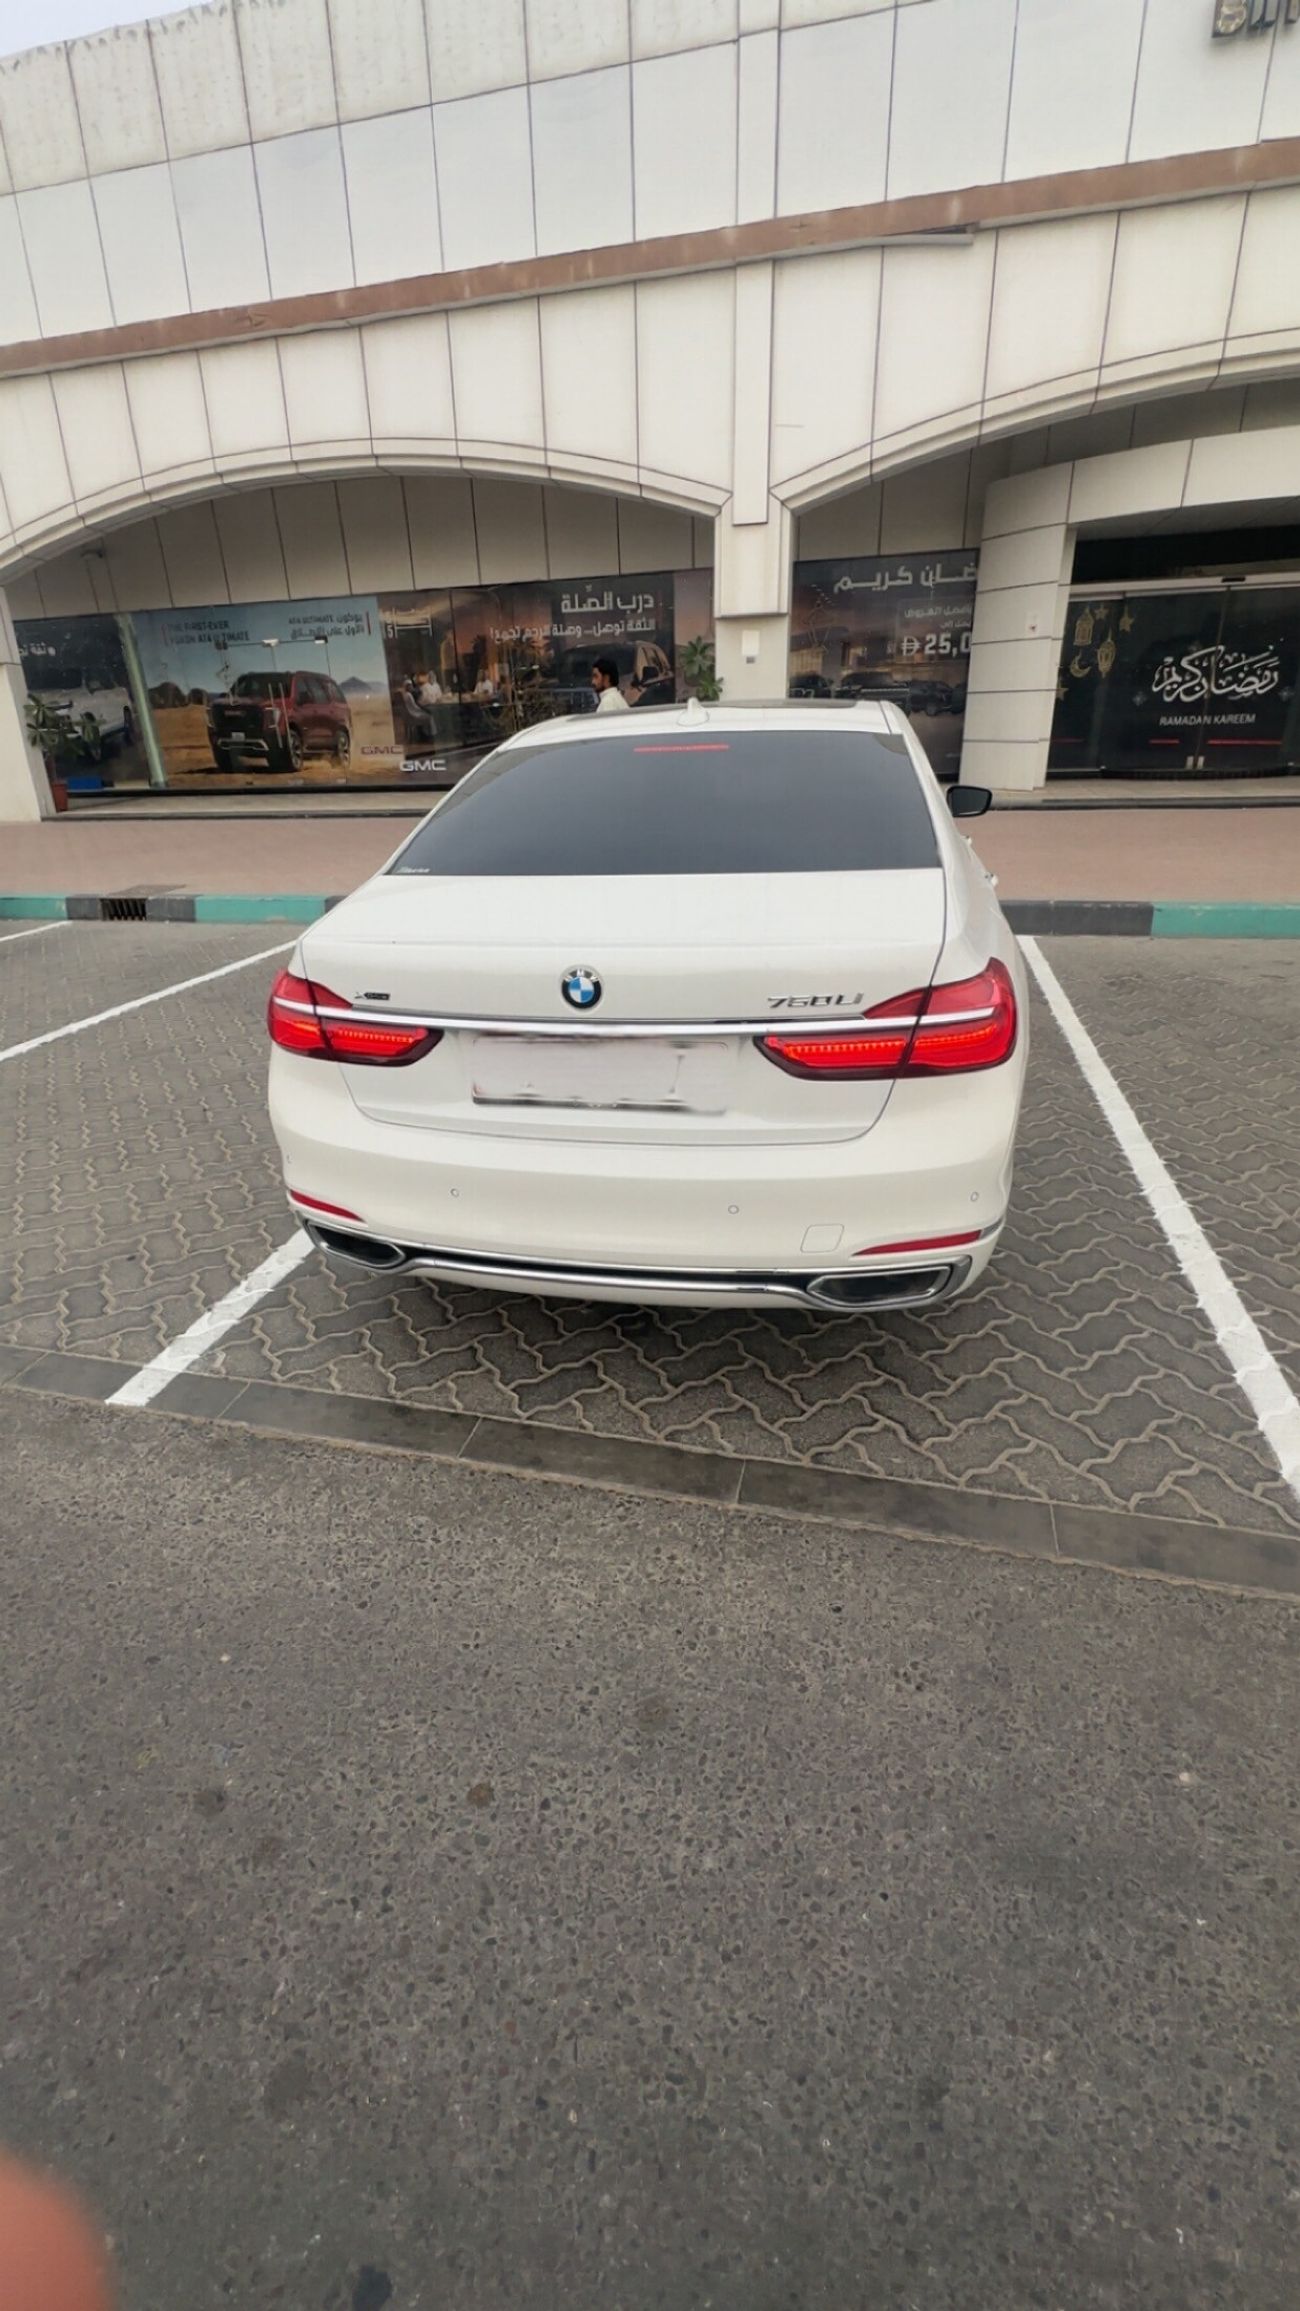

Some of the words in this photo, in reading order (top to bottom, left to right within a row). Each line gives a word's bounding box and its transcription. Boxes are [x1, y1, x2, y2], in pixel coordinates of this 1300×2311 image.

[834, 566, 913, 594] كريم
[617, 593, 655, 614] درب
[1160, 715, 1212, 726] RAMADAN
[1213, 713, 1257, 725] KAREEM
[360, 746, 403, 755] GMC
[400, 760, 447, 772] GMC
